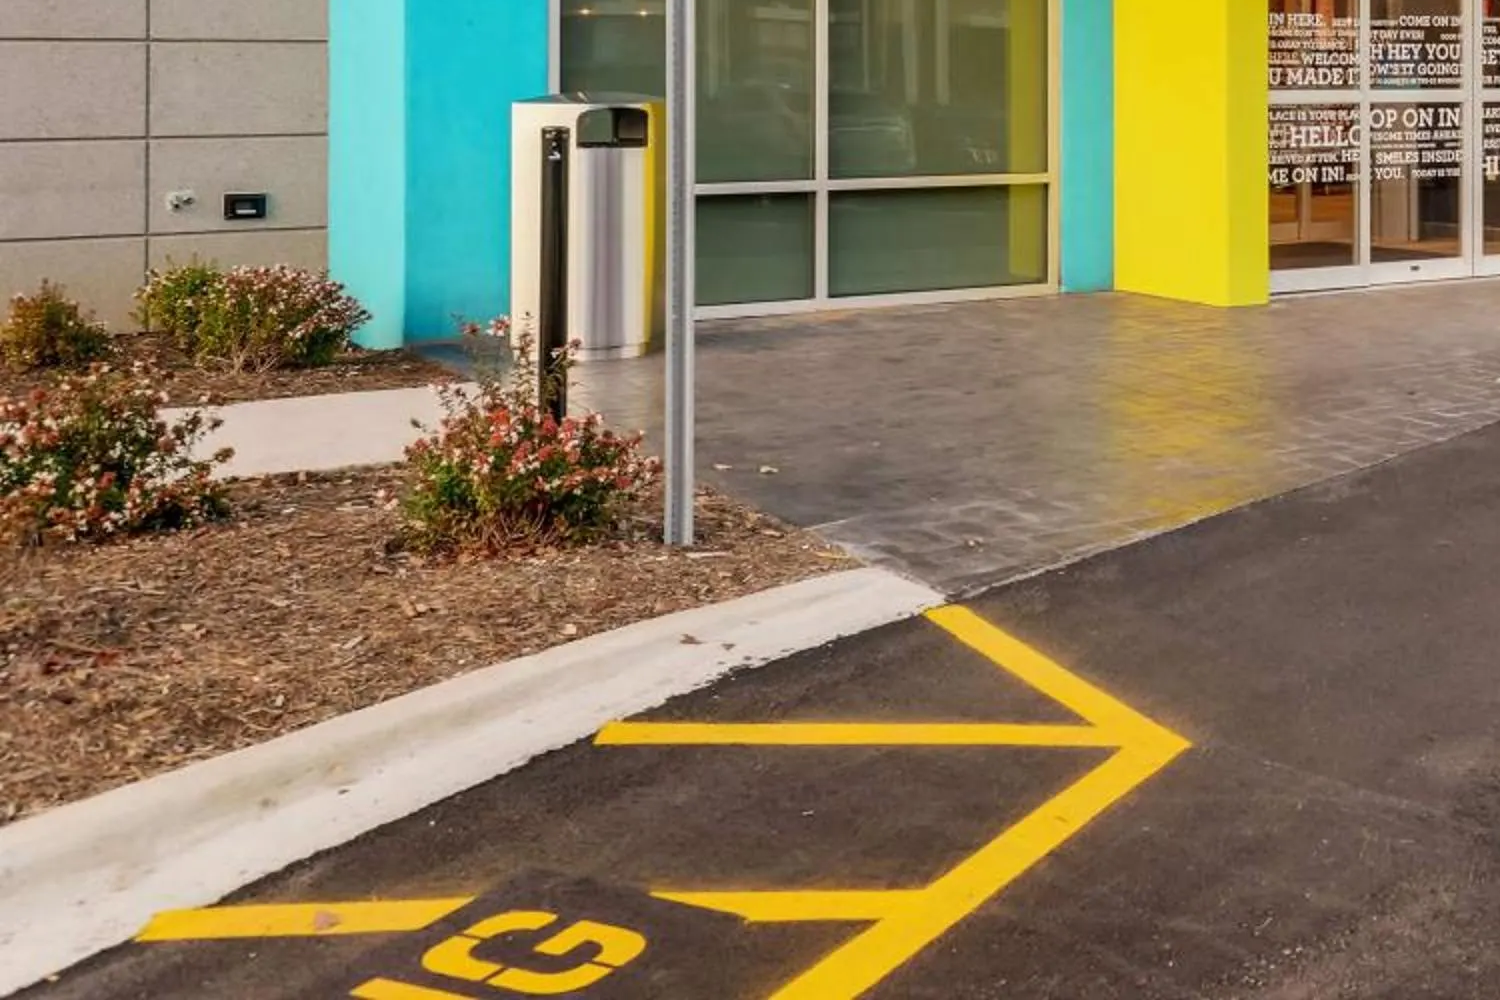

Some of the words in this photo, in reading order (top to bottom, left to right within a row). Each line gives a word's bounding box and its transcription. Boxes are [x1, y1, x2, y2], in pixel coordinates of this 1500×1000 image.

[1399, 14, 1430, 27] COME
[1432, 15, 1449, 28] ON
[1387, 43, 1422, 60] HEY
[1425, 43, 1461, 60] YOU
[1286, 67, 1343, 86] MADE
[1402, 107, 1434, 128] ON
[1437, 107, 1461, 127] IN
[1375, 151, 1419, 165] SMILES
[1291, 166, 1318, 182] ON
[1321, 165, 1345, 183] IN!
[1374, 167, 1405, 180] YOU.
